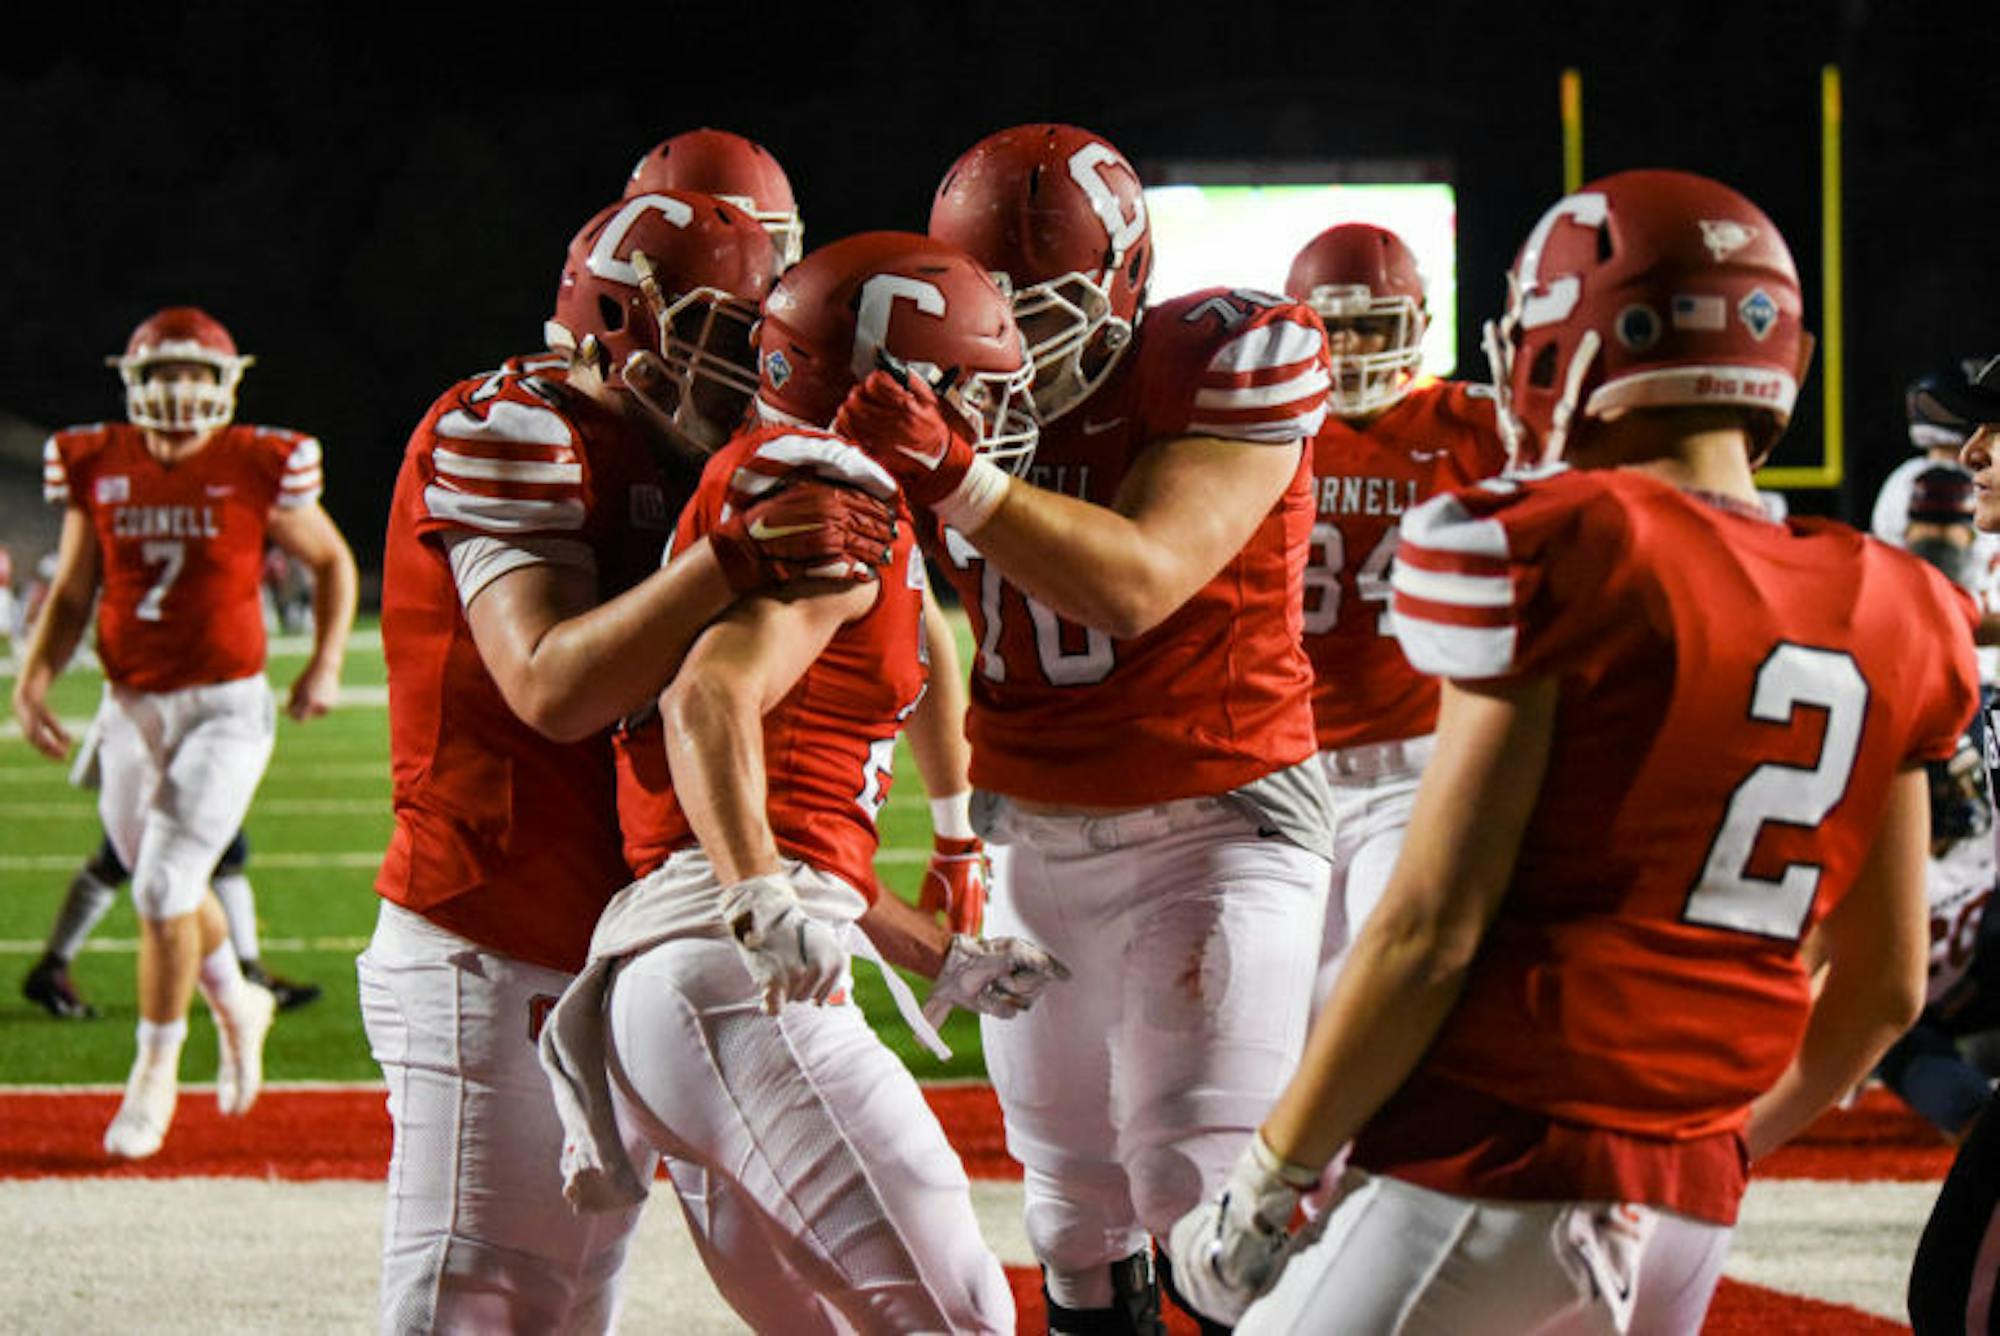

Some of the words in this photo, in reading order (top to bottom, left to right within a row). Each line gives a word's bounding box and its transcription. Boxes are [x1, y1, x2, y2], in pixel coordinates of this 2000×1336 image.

[586, 193, 693, 286] C
[1068, 141, 1146, 252] C
[1518, 191, 1608, 330] C
[852, 273, 947, 385] C
[114, 505, 220, 538] CORNELL
[136, 541, 186, 622] 7
[1681, 640, 1871, 943] 2
